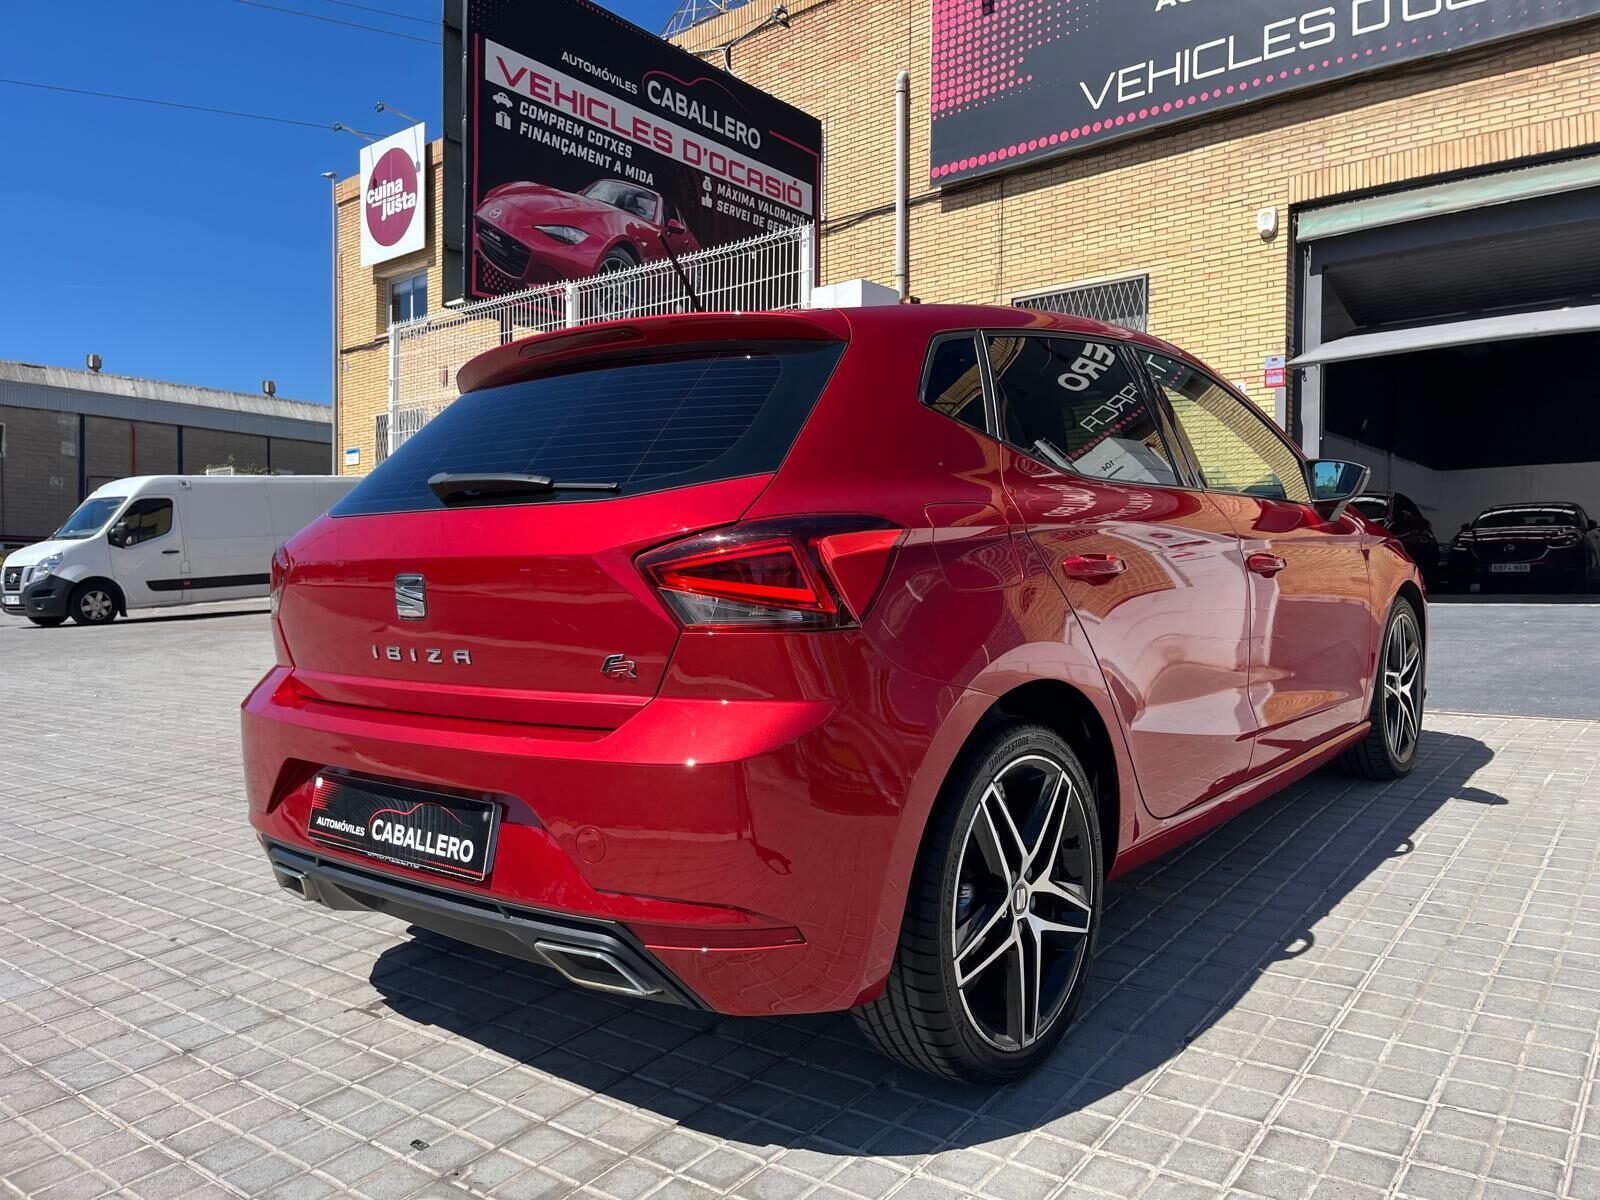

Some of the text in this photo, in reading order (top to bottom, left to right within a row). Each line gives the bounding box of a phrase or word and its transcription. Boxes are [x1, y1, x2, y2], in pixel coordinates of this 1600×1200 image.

[1080, 6, 1335, 110] VEHICLES
[561, 51, 761, 150] AUTOMÓVILES CABALLERO
[496, 55, 803, 208] VEHICLES D'OCASIÓ
[519, 101, 633, 159] COMPREM COTXES
[519, 122, 654, 186] FINANÇAMENT A MIDA
[366, 177, 404, 204] cuina
[381, 191, 416, 222] justa
[716, 183, 755, 209] MÀXIMA
[716, 200, 750, 222] SERVEI
[753, 214, 765, 228] DE
[371, 644, 472, 665] IBIZA
[600, 653, 638, 679] FR
[316, 815, 366, 837] AUTOMÓVILES
[371, 818, 474, 863] CABALLERO
